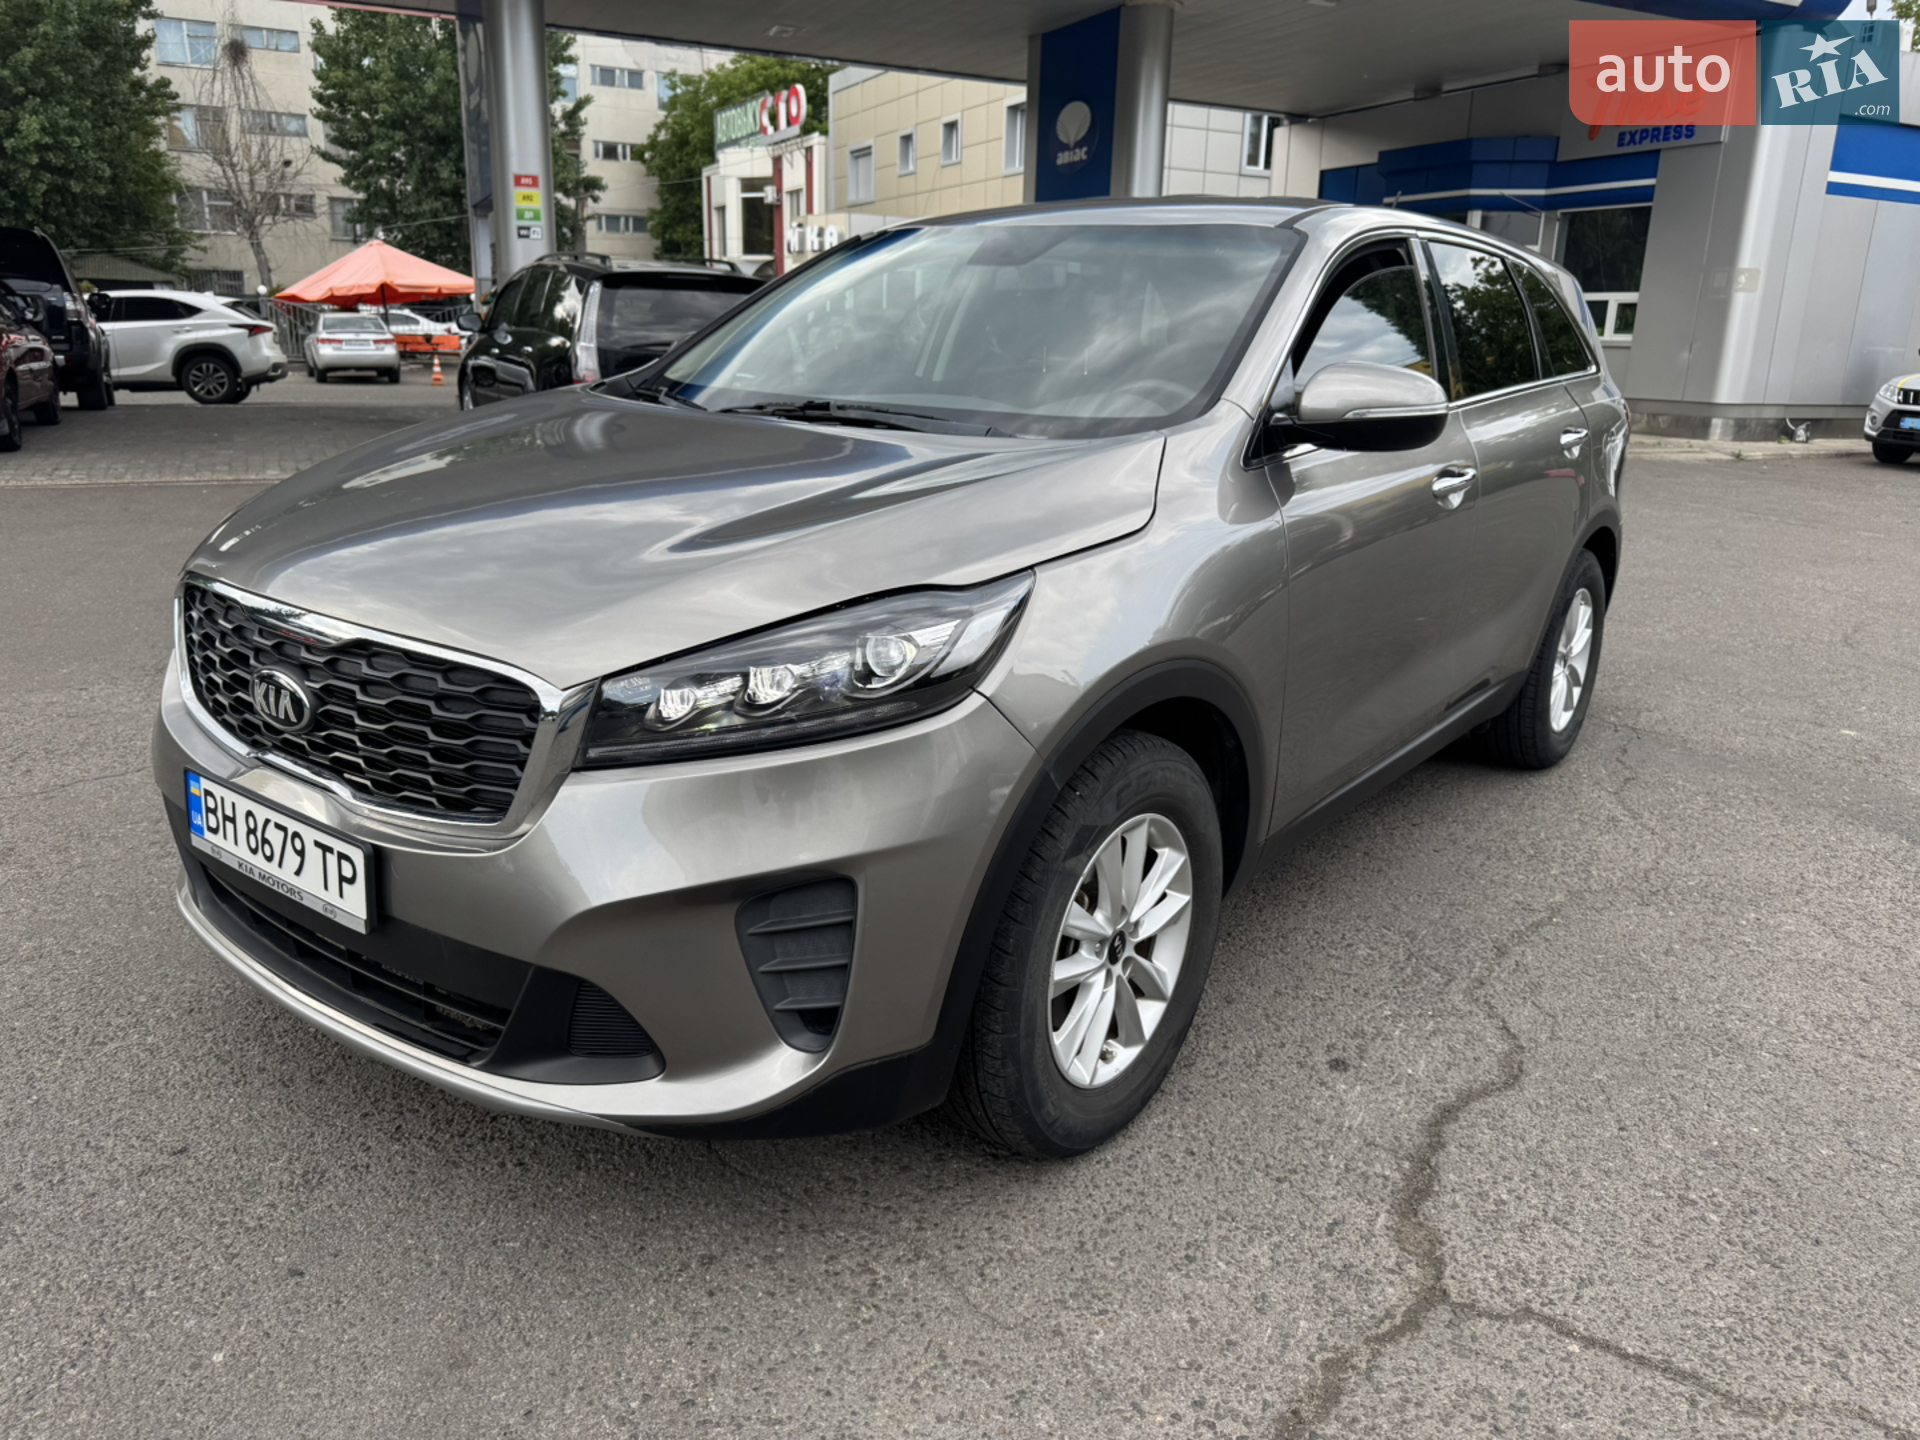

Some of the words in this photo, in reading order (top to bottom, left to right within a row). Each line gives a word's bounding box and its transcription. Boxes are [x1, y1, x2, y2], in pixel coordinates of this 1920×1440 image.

[760, 84, 805, 137] СТО
[1617, 122, 1697, 148] EXPRESS
[254, 680, 298, 723] KIA
[192, 810, 204, 827] UA
[203, 788, 238, 847] BH
[245, 809, 306, 876] 8679
[313, 839, 357, 899] TP
[237, 860, 256, 877] KIA
[258, 872, 304, 901] MOTORS
